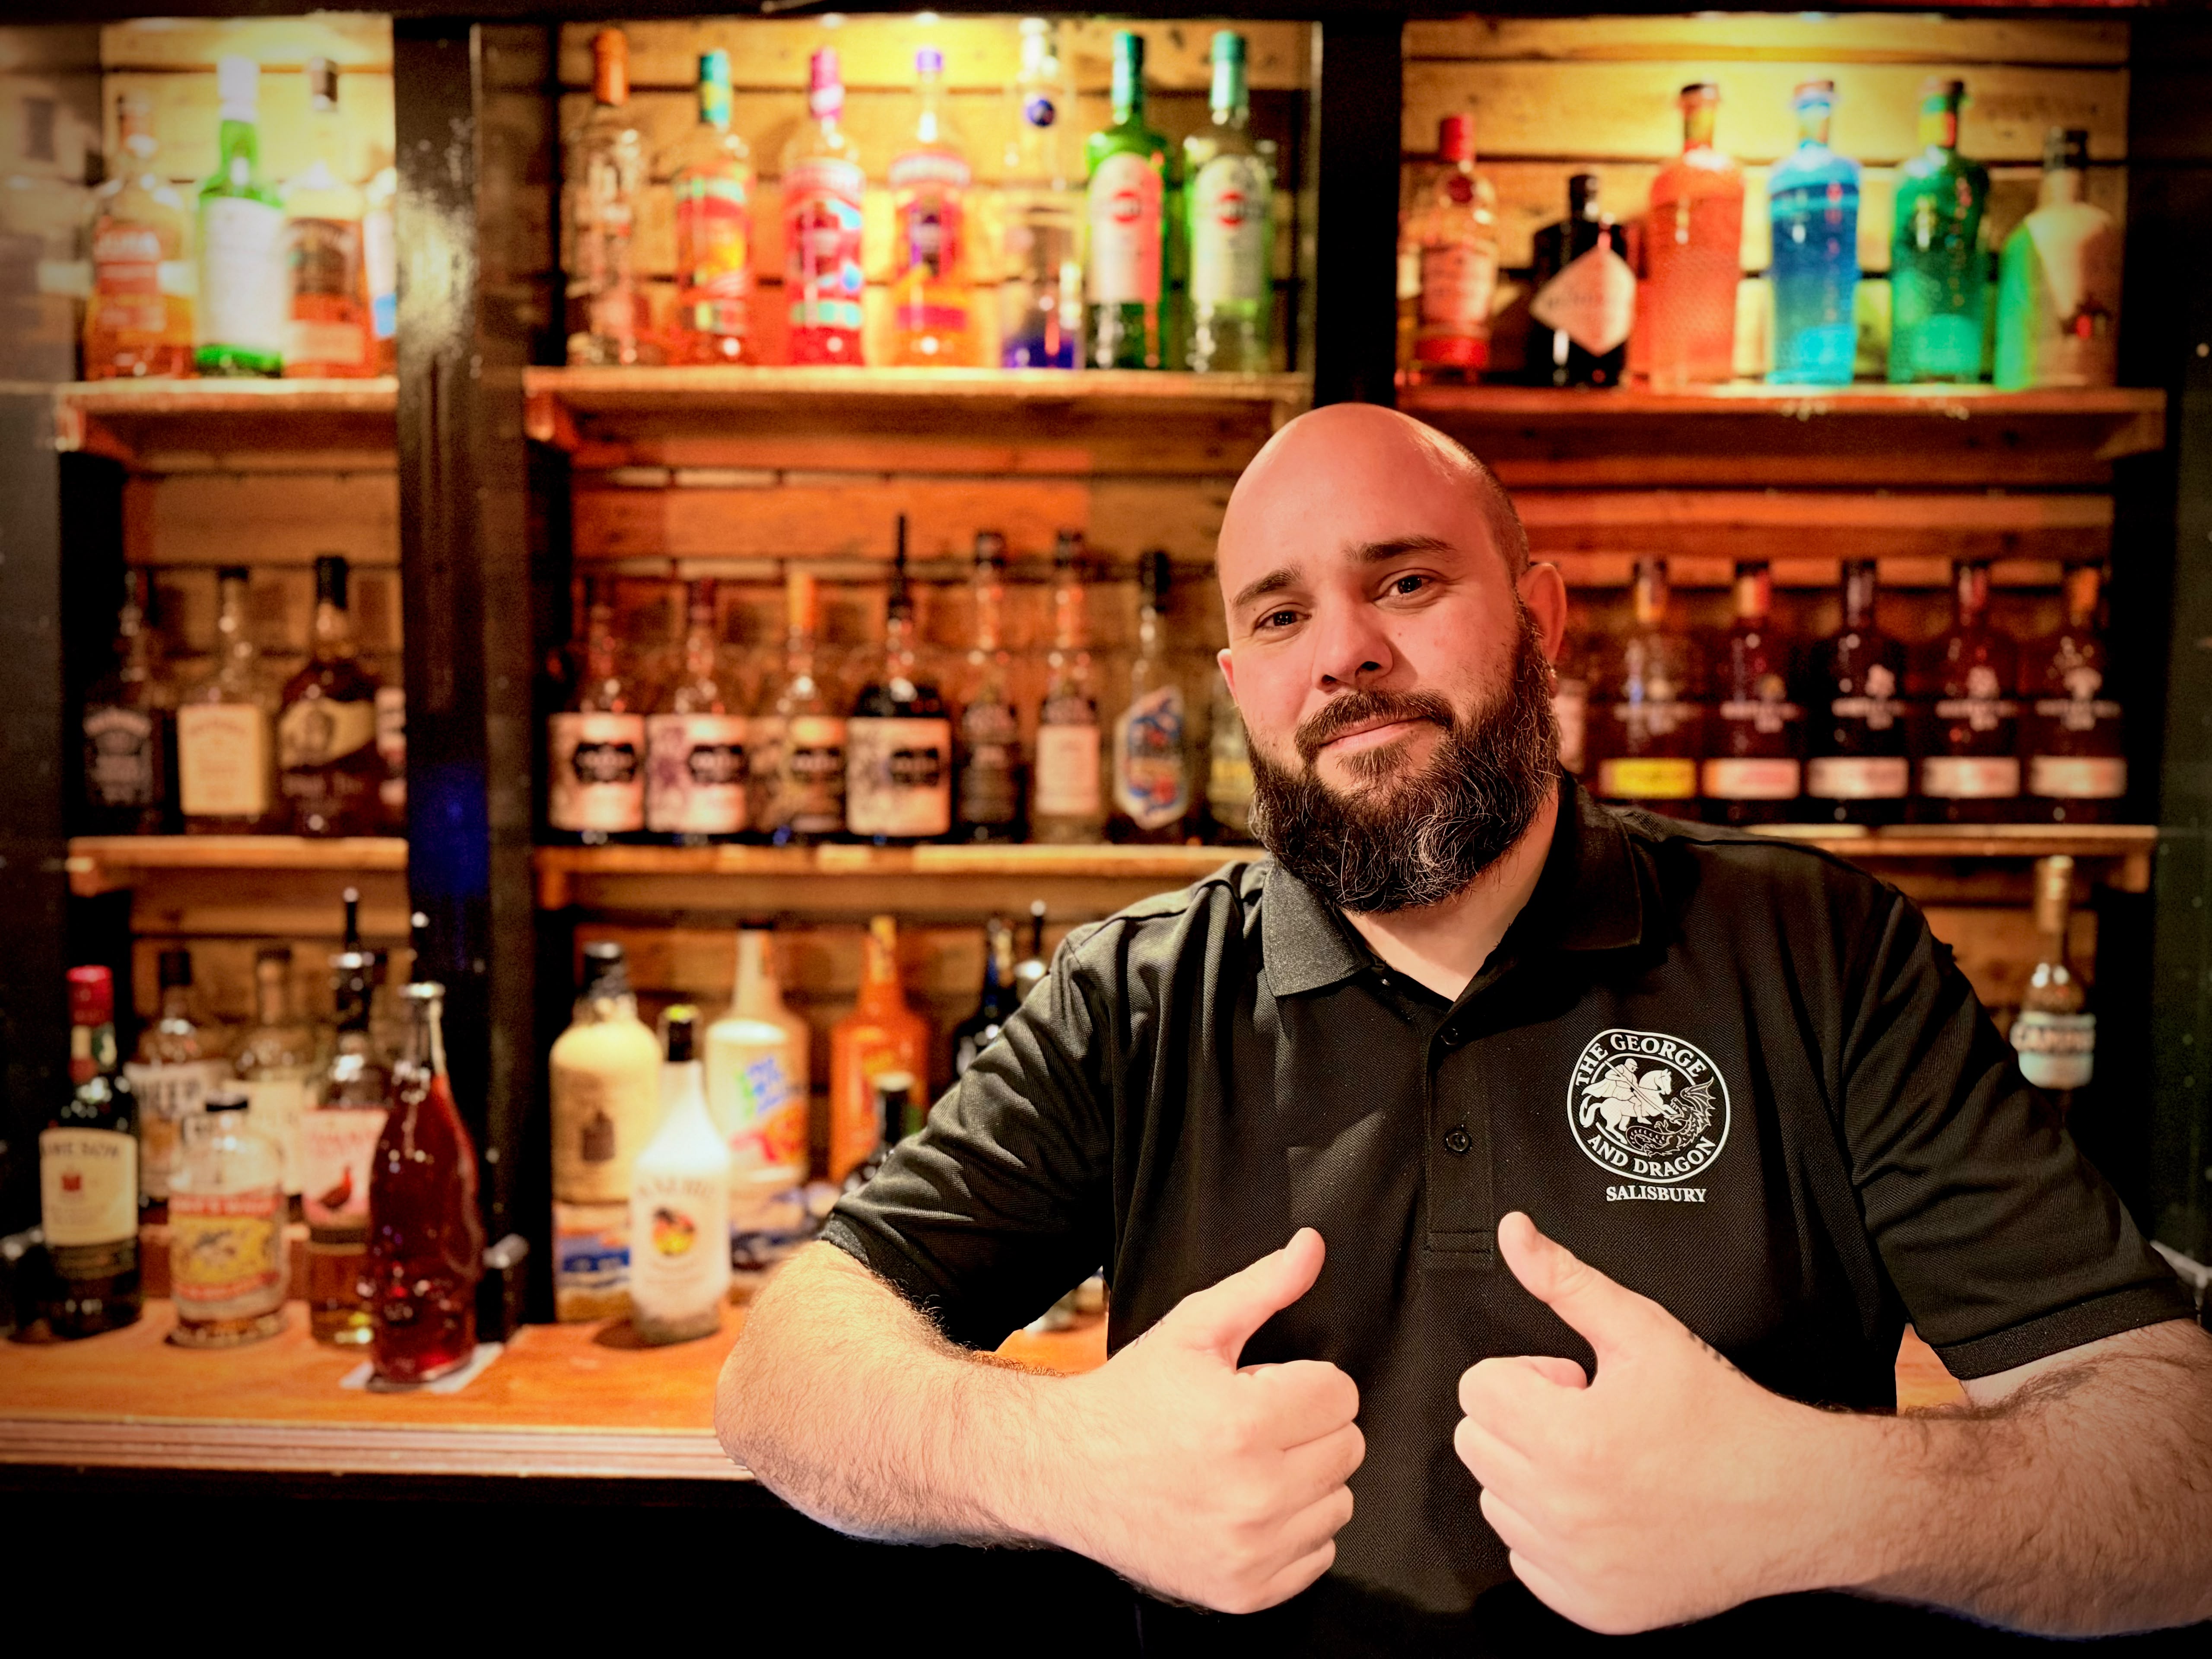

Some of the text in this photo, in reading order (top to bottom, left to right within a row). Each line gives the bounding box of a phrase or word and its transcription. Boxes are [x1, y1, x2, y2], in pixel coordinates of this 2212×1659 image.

[1576, 1034, 1707, 1086] THE GEORGE
[1587, 1135, 1716, 1177] AND DRAGON
[1606, 1185, 1707, 1202] SALISBURY
